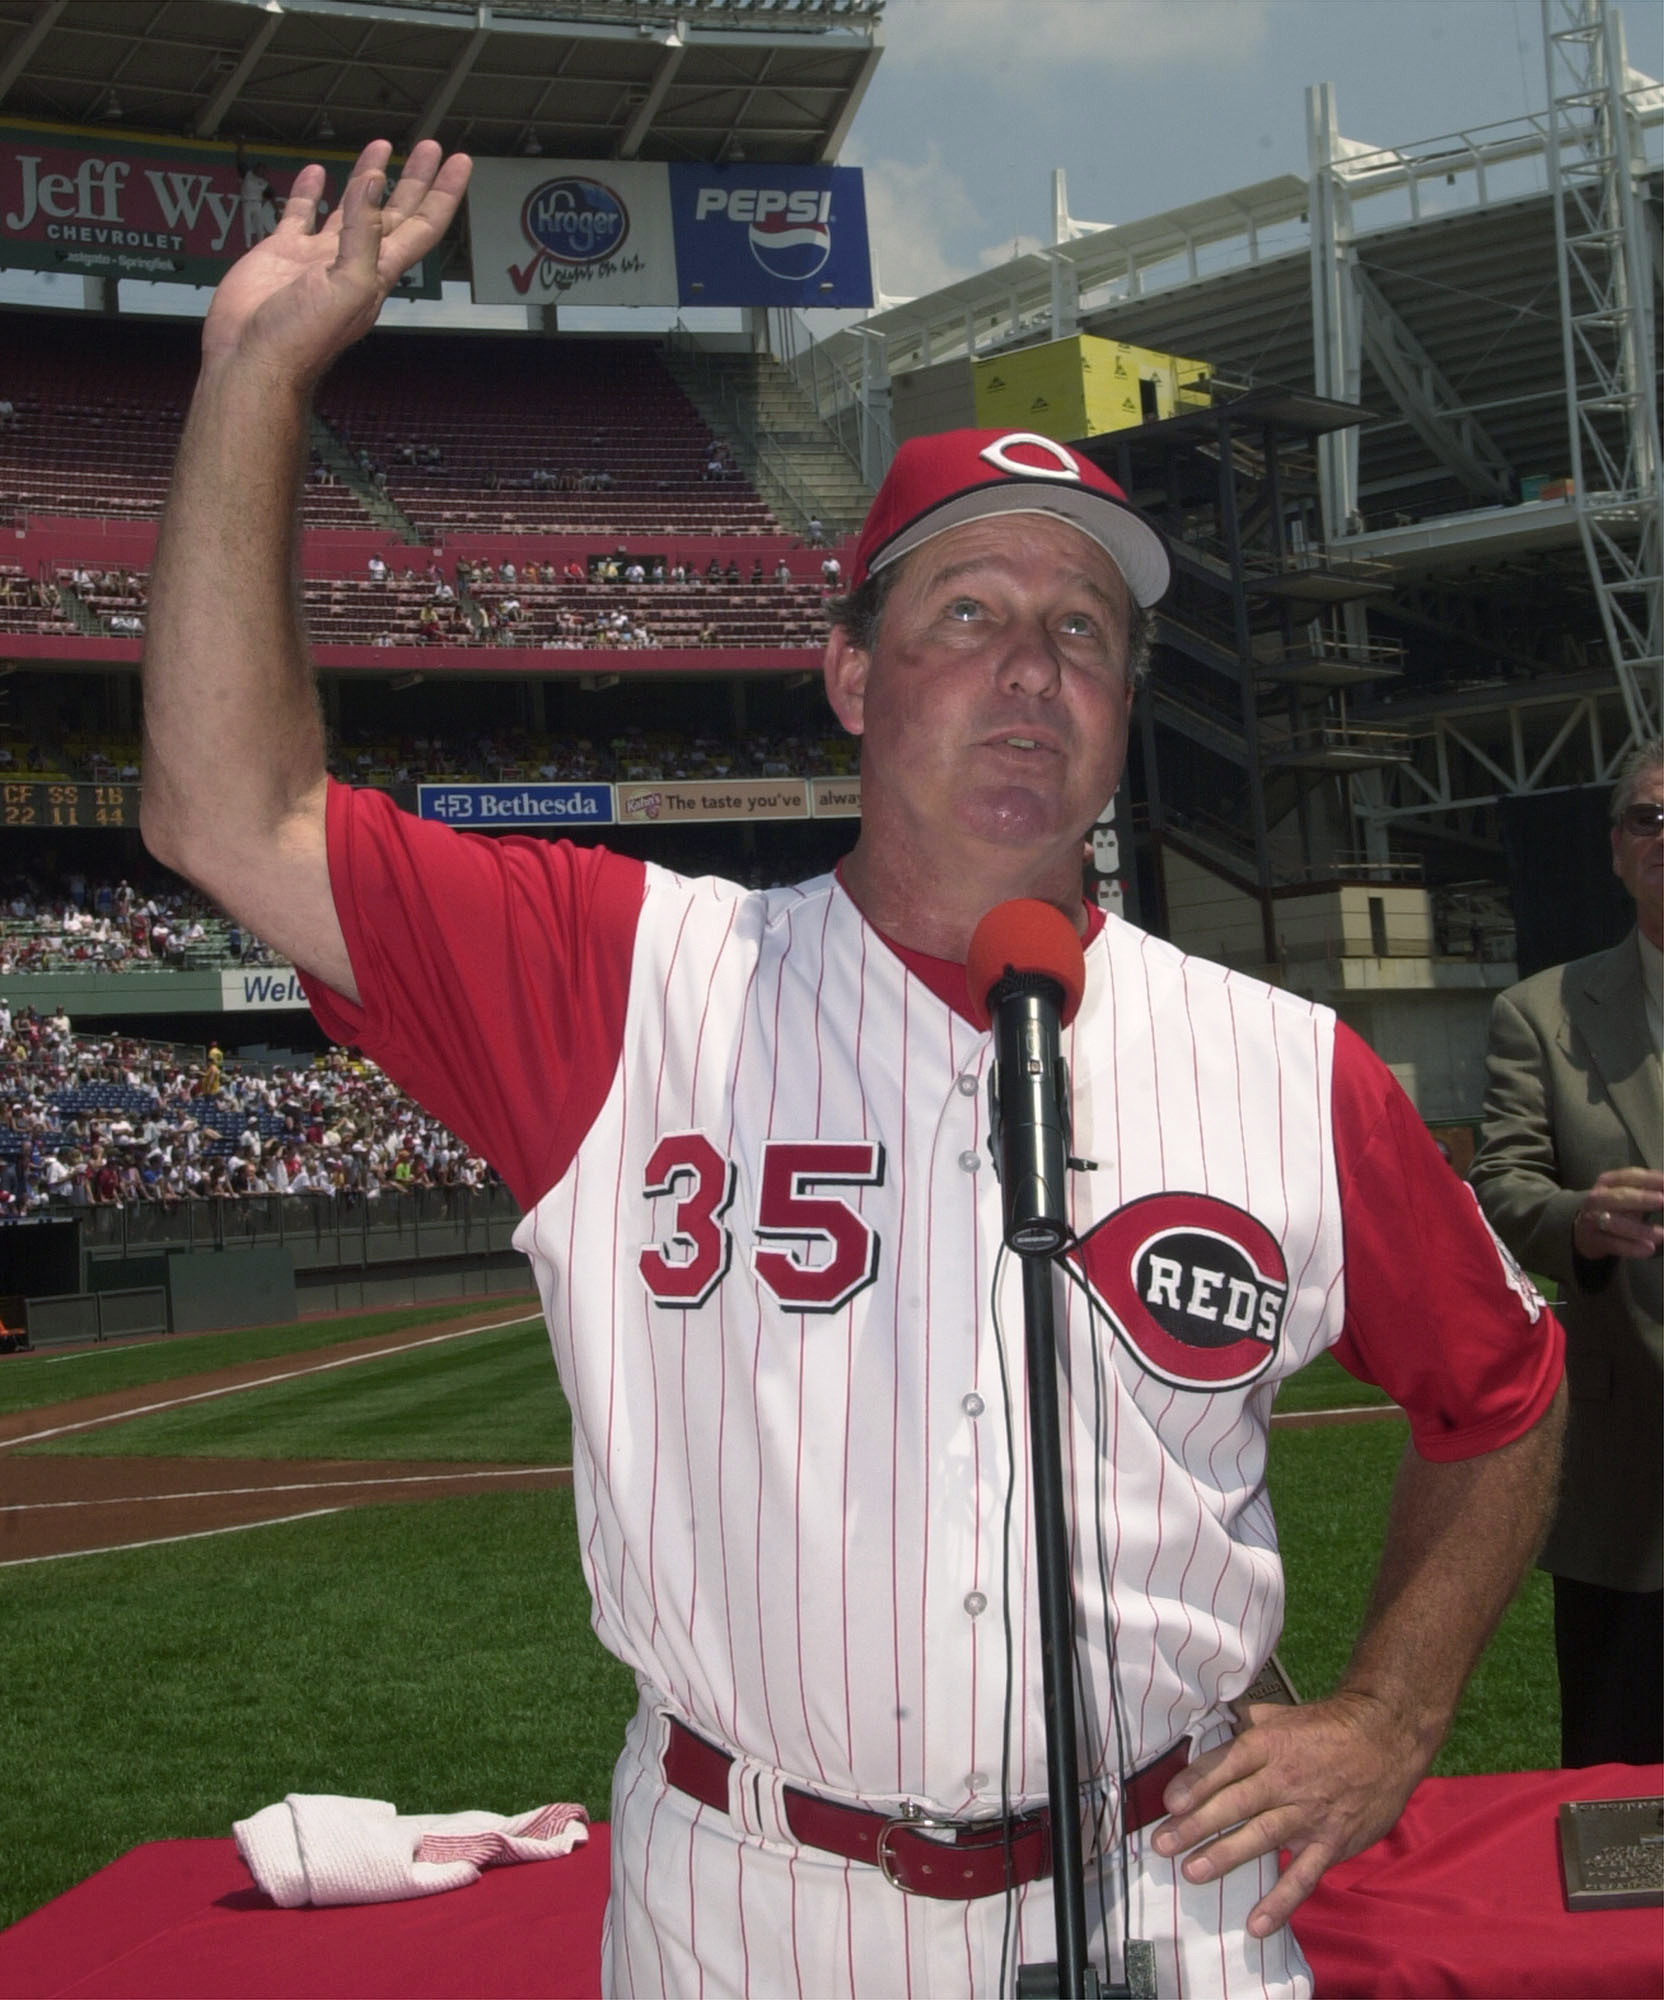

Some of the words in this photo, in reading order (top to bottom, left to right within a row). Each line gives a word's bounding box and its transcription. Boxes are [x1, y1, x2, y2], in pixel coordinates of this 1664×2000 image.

[7, 154, 130, 231] Jeff
[695, 188, 833, 223] PEPSI
[537, 190, 619, 252] Kroger
[47, 224, 184, 251] CHEVROLET
[48, 785, 78, 804] SS
[480, 793, 599, 818] Bethesda
[666, 794, 697, 810] The
[702, 793, 743, 810] taste
[747, 793, 801, 812] you've
[5, 806, 36, 825] 22
[53, 807, 78, 826] 11
[244, 974, 307, 1003] Welc
[638, 1128, 886, 1314] 35
[1146, 1254, 1284, 1341] REDS
